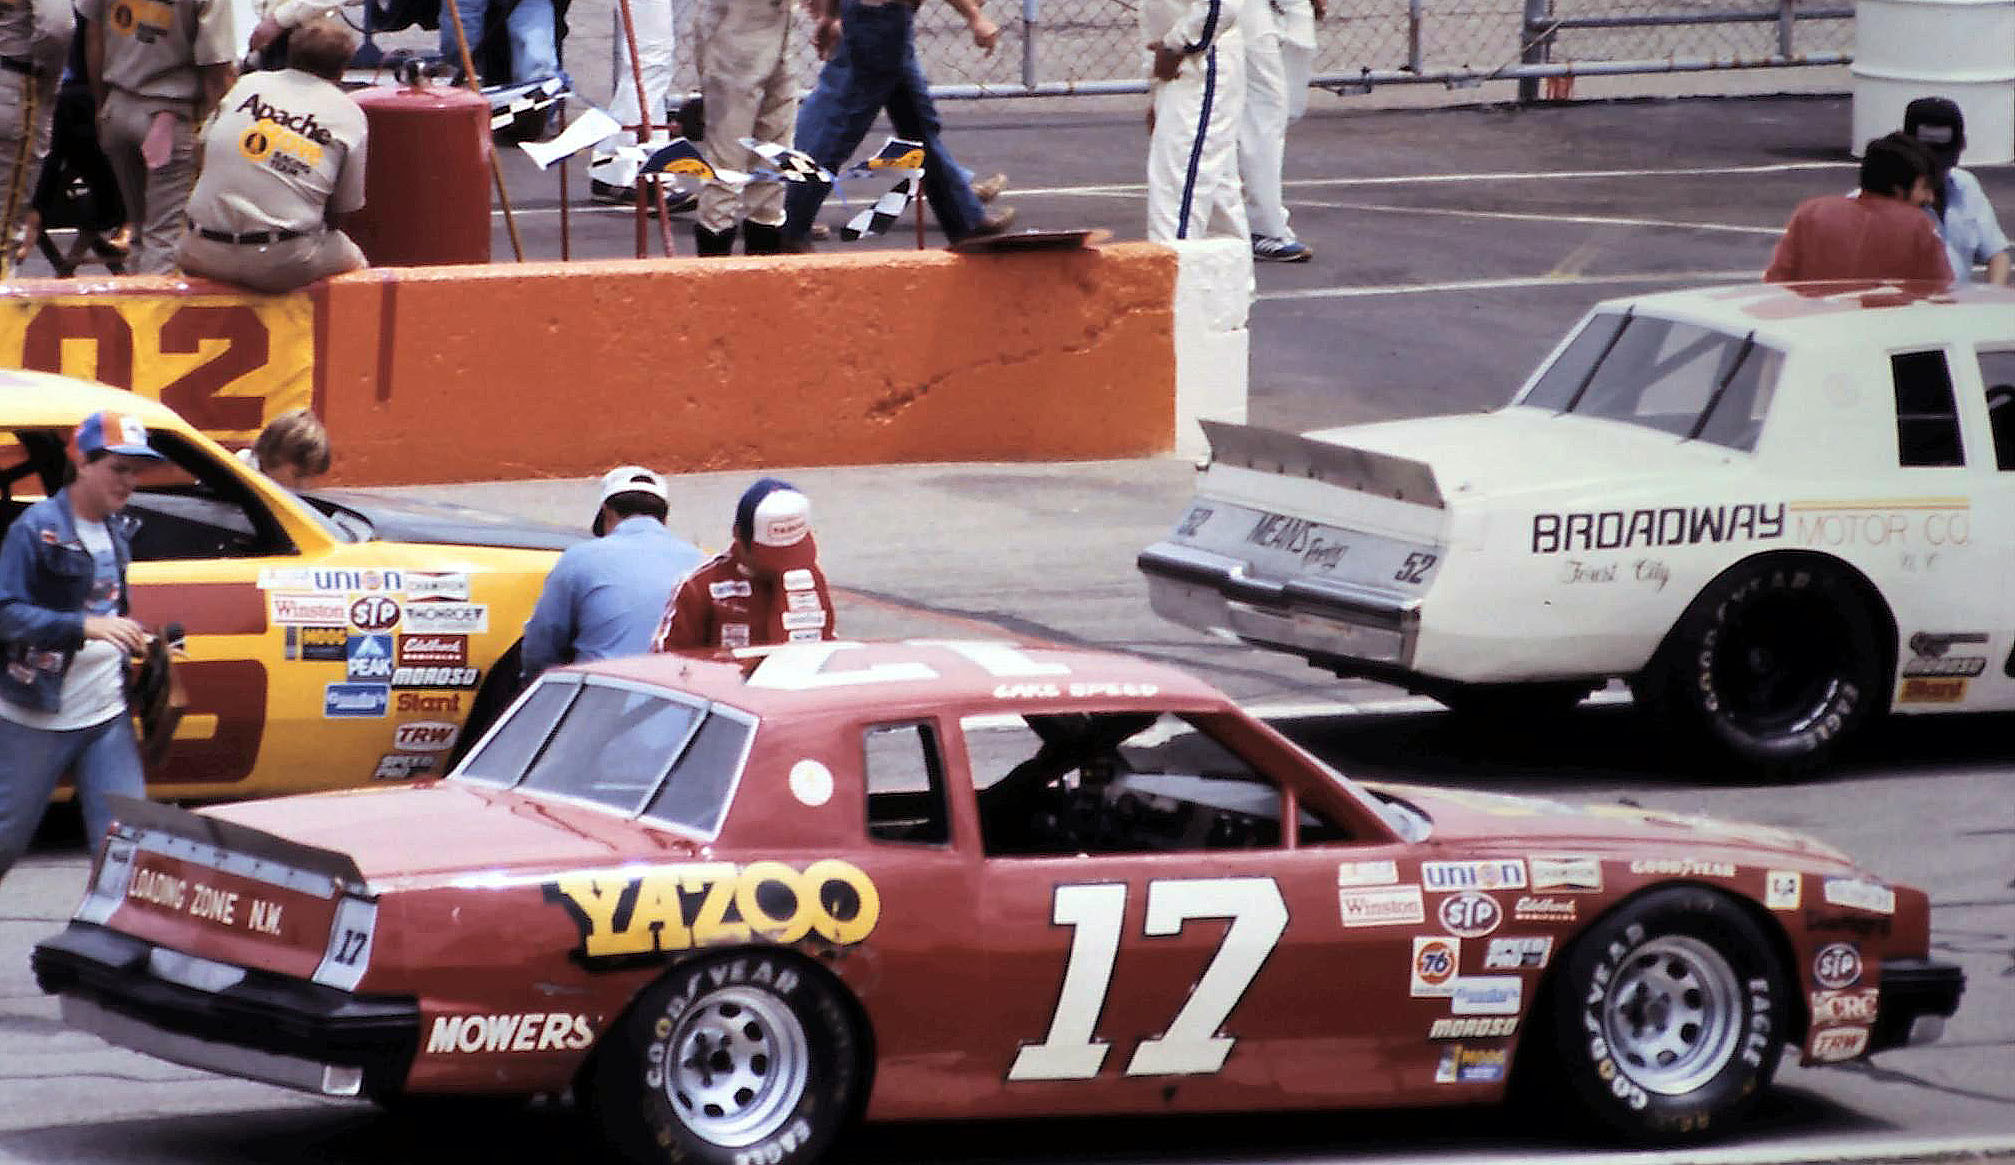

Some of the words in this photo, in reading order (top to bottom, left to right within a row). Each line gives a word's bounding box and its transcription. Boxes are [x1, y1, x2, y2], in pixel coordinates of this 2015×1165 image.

[234, 93, 333, 146] Apache
[22, 304, 270, 431] 02
[1532, 502, 1785, 553] BROADWAY
[1798, 514, 1908, 546] MOTOR
[1394, 552, 1437, 584] 52
[274, 599, 345, 619] Winston
[352, 598, 399, 628] STP
[349, 657, 392, 677] PEAK
[391, 668, 477, 686] MOROSO
[398, 693, 459, 712] Stant
[400, 727, 453, 743] TRW
[190, 883, 239, 926] ZONE
[556, 859, 881, 958] YAZOO
[1345, 898, 1417, 916] Winston
[1447, 898, 1494, 929] STP
[335, 930, 368, 965] 17
[1424, 952, 1448, 972] 76
[1821, 948, 1854, 978] STP
[1006, 876, 1290, 1081] 17
[646, 959, 799, 1088] GOODYEAR
[1430, 1018, 1518, 1038] MOROSO
[1584, 923, 1648, 1110] GOODYEAR
[1742, 978, 1771, 1068] EAGLE
[426, 1013, 595, 1054] MOWERS
